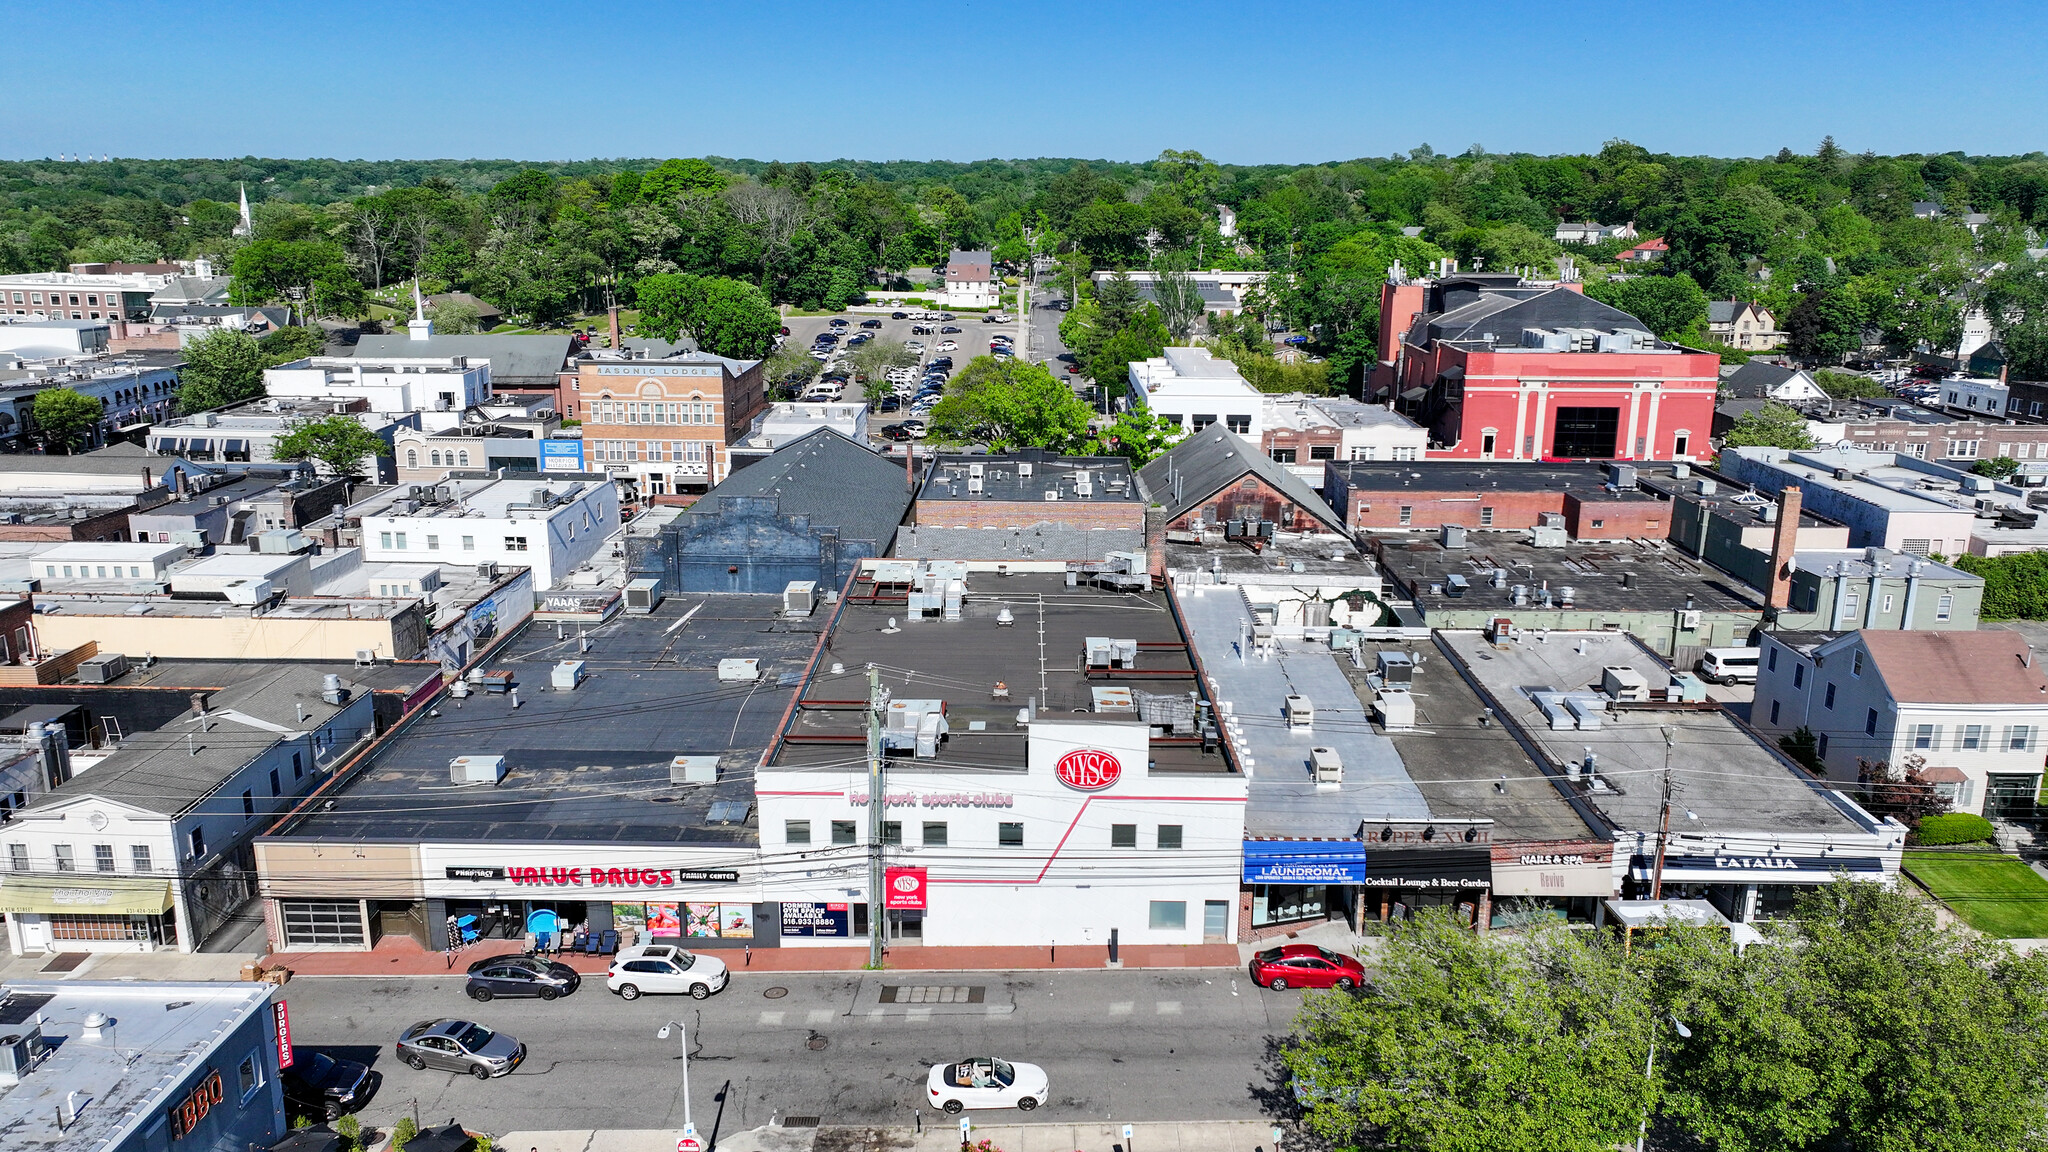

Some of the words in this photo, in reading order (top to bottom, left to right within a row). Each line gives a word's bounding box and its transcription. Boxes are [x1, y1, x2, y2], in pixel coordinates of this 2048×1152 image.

[663, 368, 708, 376] LODGE
[546, 597, 580, 607] YAAAS
[1064, 754, 1113, 785] NYSC
[921, 793, 970, 808] sports
[972, 792, 1014, 806] clubs
[1520, 855, 1552, 865] NAILS
[1552, 855, 1562, 864] &
[1563, 856, 1583, 865] SPA
[455, 869, 494, 878] PHARMACY
[507, 866, 582, 884] VALUE
[589, 867, 674, 886] DRUGS
[682, 872, 707, 880] FAMILY
[1261, 867, 1349, 876] LAUNDROMAT
[1365, 877, 1399, 887] Cocktail
[1400, 878, 1430, 888] Lounge
[1431, 879, 1439, 887] &
[1440, 879, 1459, 887] Beer
[1460, 879, 1491, 887] Garden
[1540, 872, 1565, 888] Revive
[276, 1003, 291, 1061] BURGERS
[182, 1074, 224, 1136] BBQ
